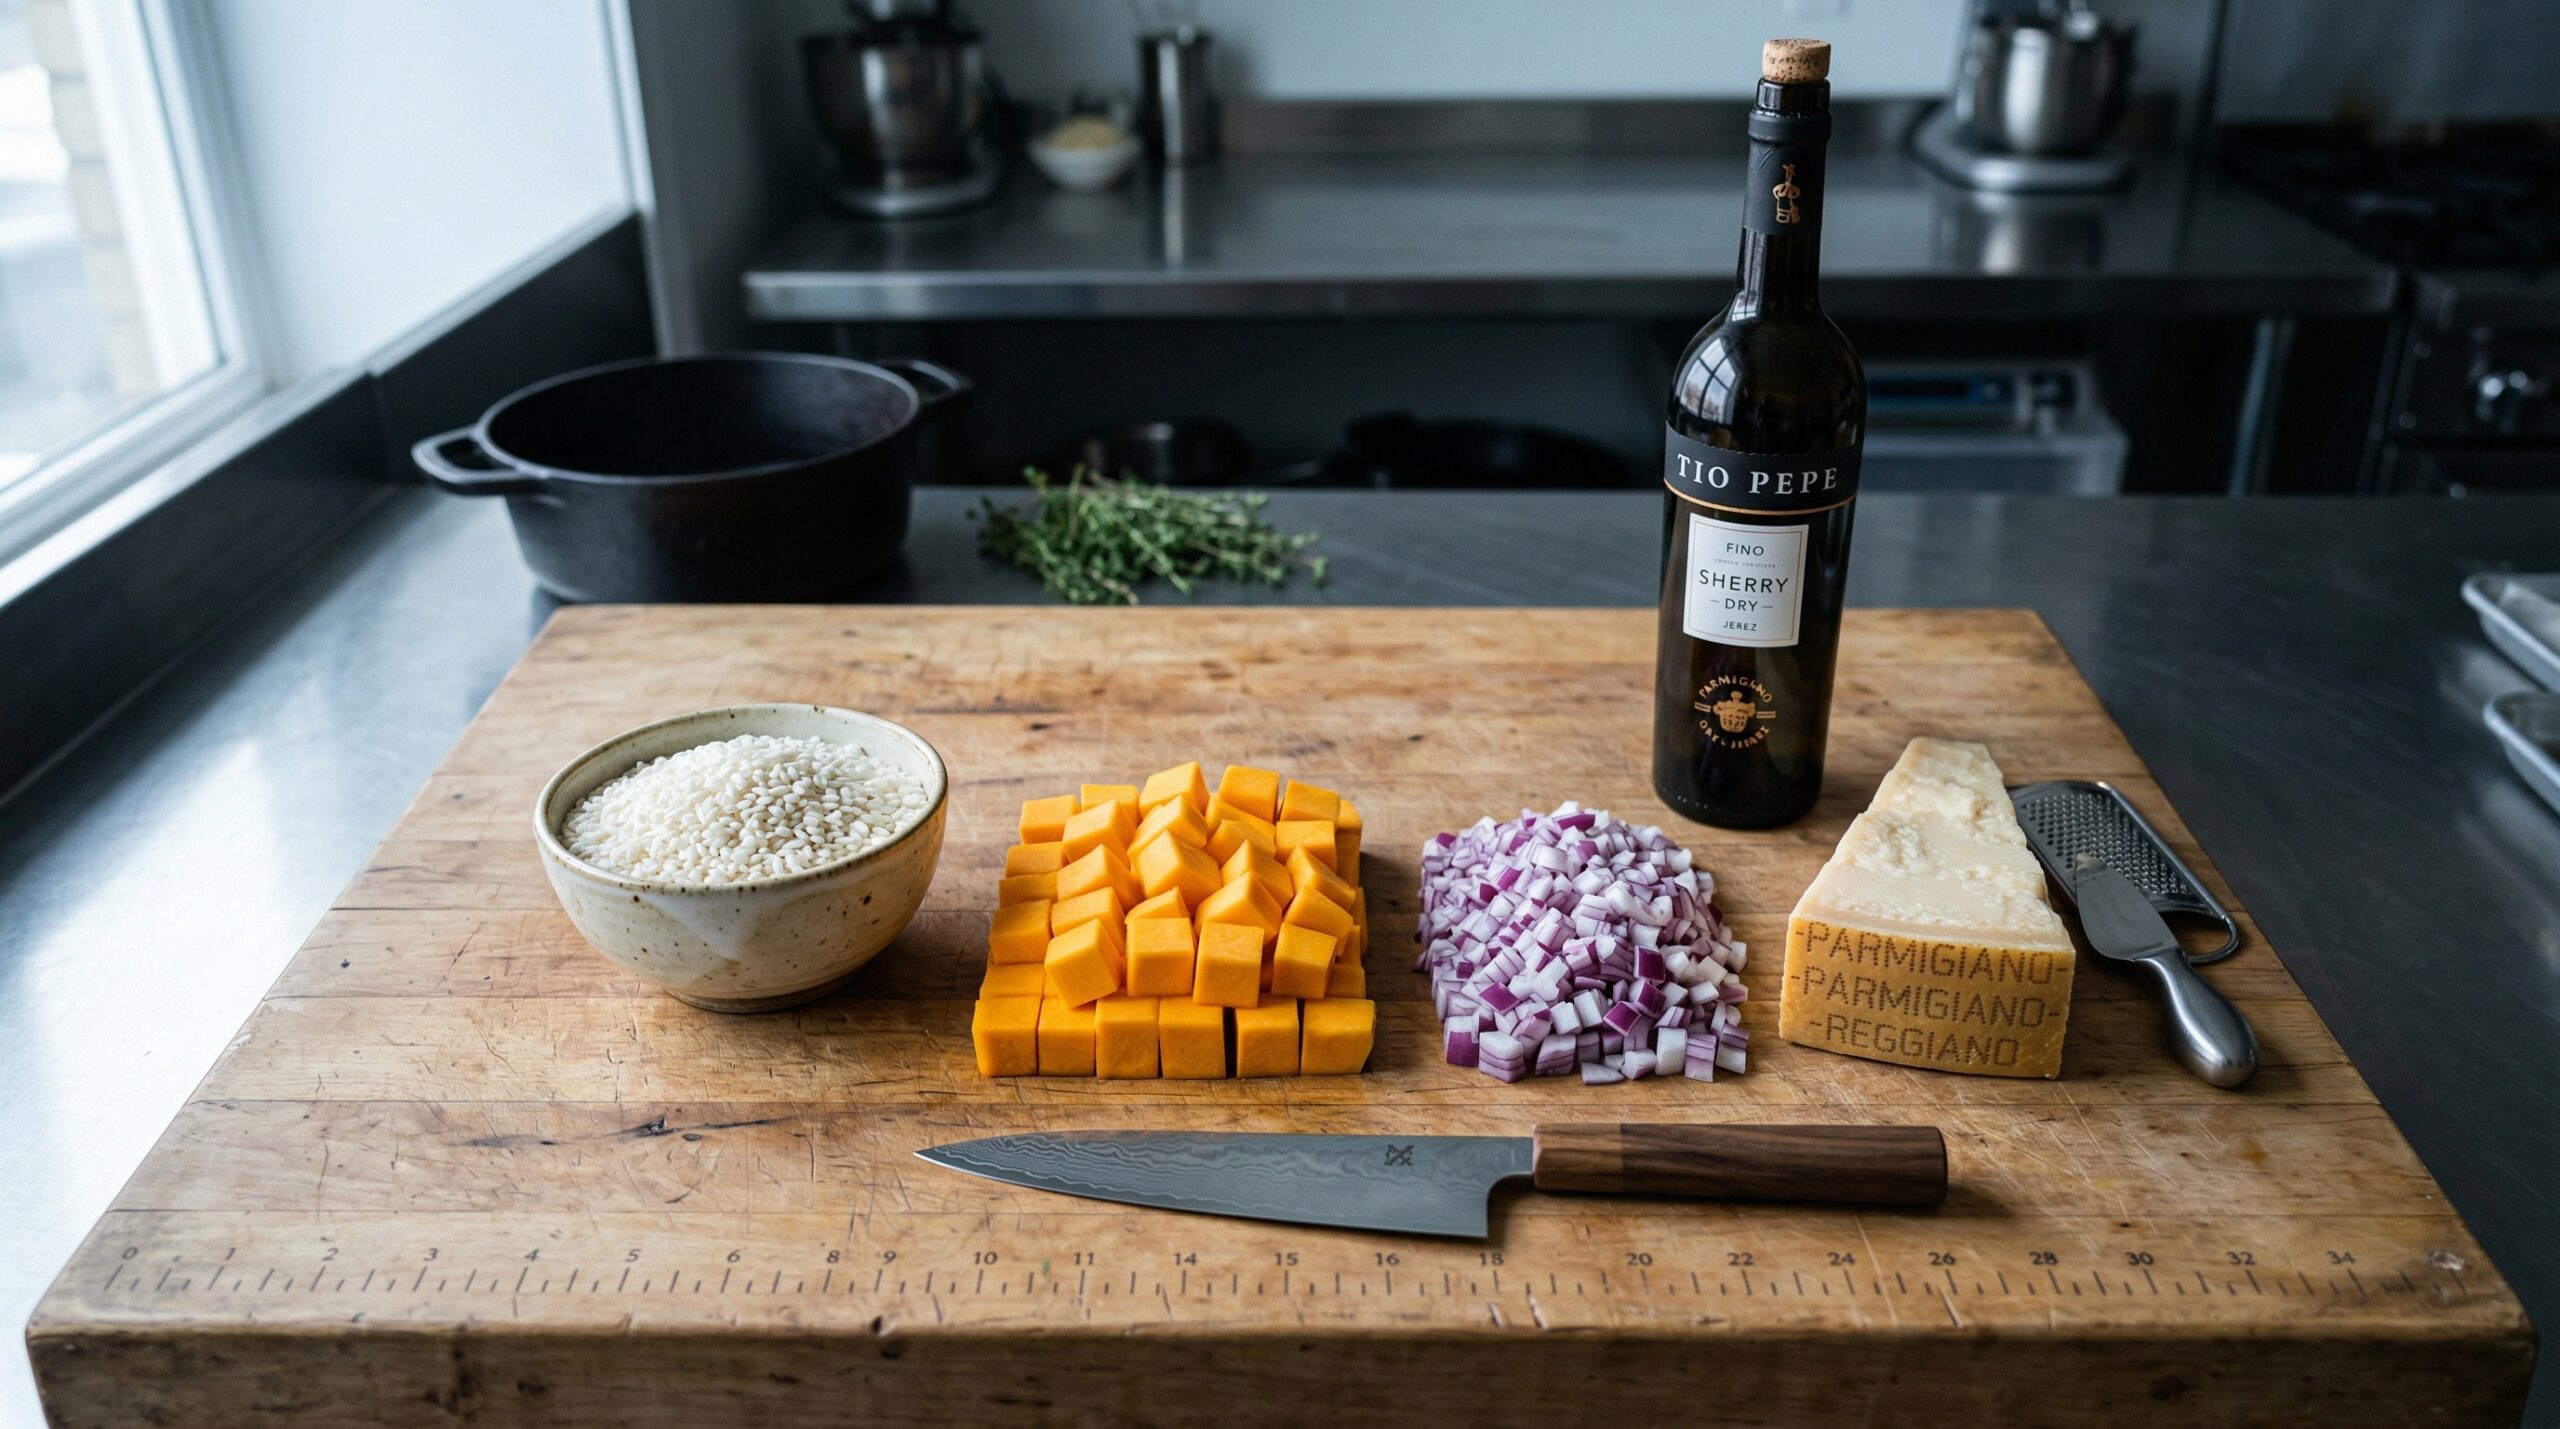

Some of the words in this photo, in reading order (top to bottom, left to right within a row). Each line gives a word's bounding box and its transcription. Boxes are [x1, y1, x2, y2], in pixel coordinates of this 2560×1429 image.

[1677, 453, 1730, 489] TIO
[1749, 467, 1838, 495] PEPE
[1726, 542, 1765, 556] FINO
[1699, 569, 1789, 593] SHERRY
[1725, 598, 1758, 612] DRY
[1723, 621, 1757, 632] JEREZ
[122, 1246, 139, 1261] 0
[225, 1247, 237, 1261] 1
[322, 1247, 339, 1262] 2
[423, 1247, 439, 1262] 3
[524, 1248, 540, 1262] 4
[625, 1249, 642, 1263] 5
[726, 1249, 741, 1263] 6
[826, 1249, 841, 1263] 8
[883, 1250, 898, 1264] 9
[974, 1251, 999, 1265] 10
[1074, 1251, 1095, 1266] 11
[1174, 1252, 1198, 1266] 14
[1275, 1252, 1299, 1267] 15
[1375, 1252, 1400, 1267] 16
[1479, 1252, 1505, 1267] 18
[1626, 1252, 1654, 1267] 20
[1727, 1252, 1755, 1267] 22
[1827, 1252, 1856, 1267] 24
[1929, 1252, 1957, 1267] 26
[2030, 1251, 2059, 1266] 28
[2125, 1251, 2155, 1266] 30
[2226, 1251, 2256, 1266] 32
[2326, 1250, 2355, 1265] 34
